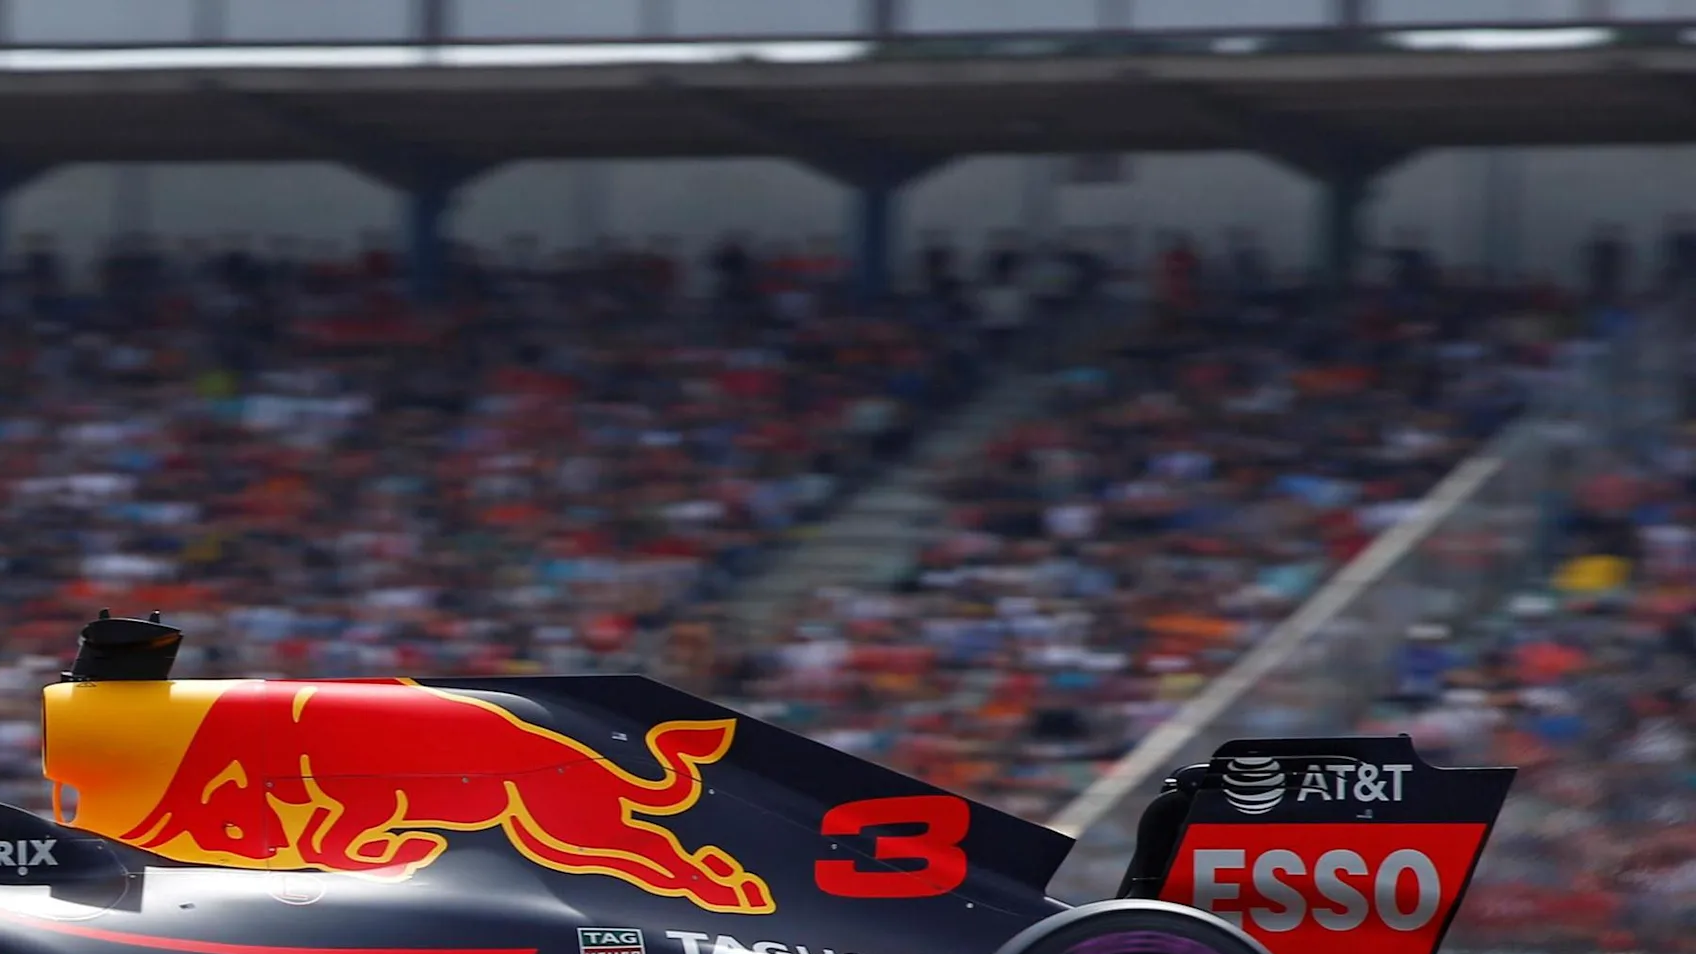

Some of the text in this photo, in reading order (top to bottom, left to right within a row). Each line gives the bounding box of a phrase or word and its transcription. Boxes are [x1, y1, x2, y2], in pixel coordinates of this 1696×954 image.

[1297, 764, 1413, 802] AT&T
[814, 795, 971, 898] 3
[1193, 849, 1441, 932] ESSO
[583, 932, 638, 944] TAG
